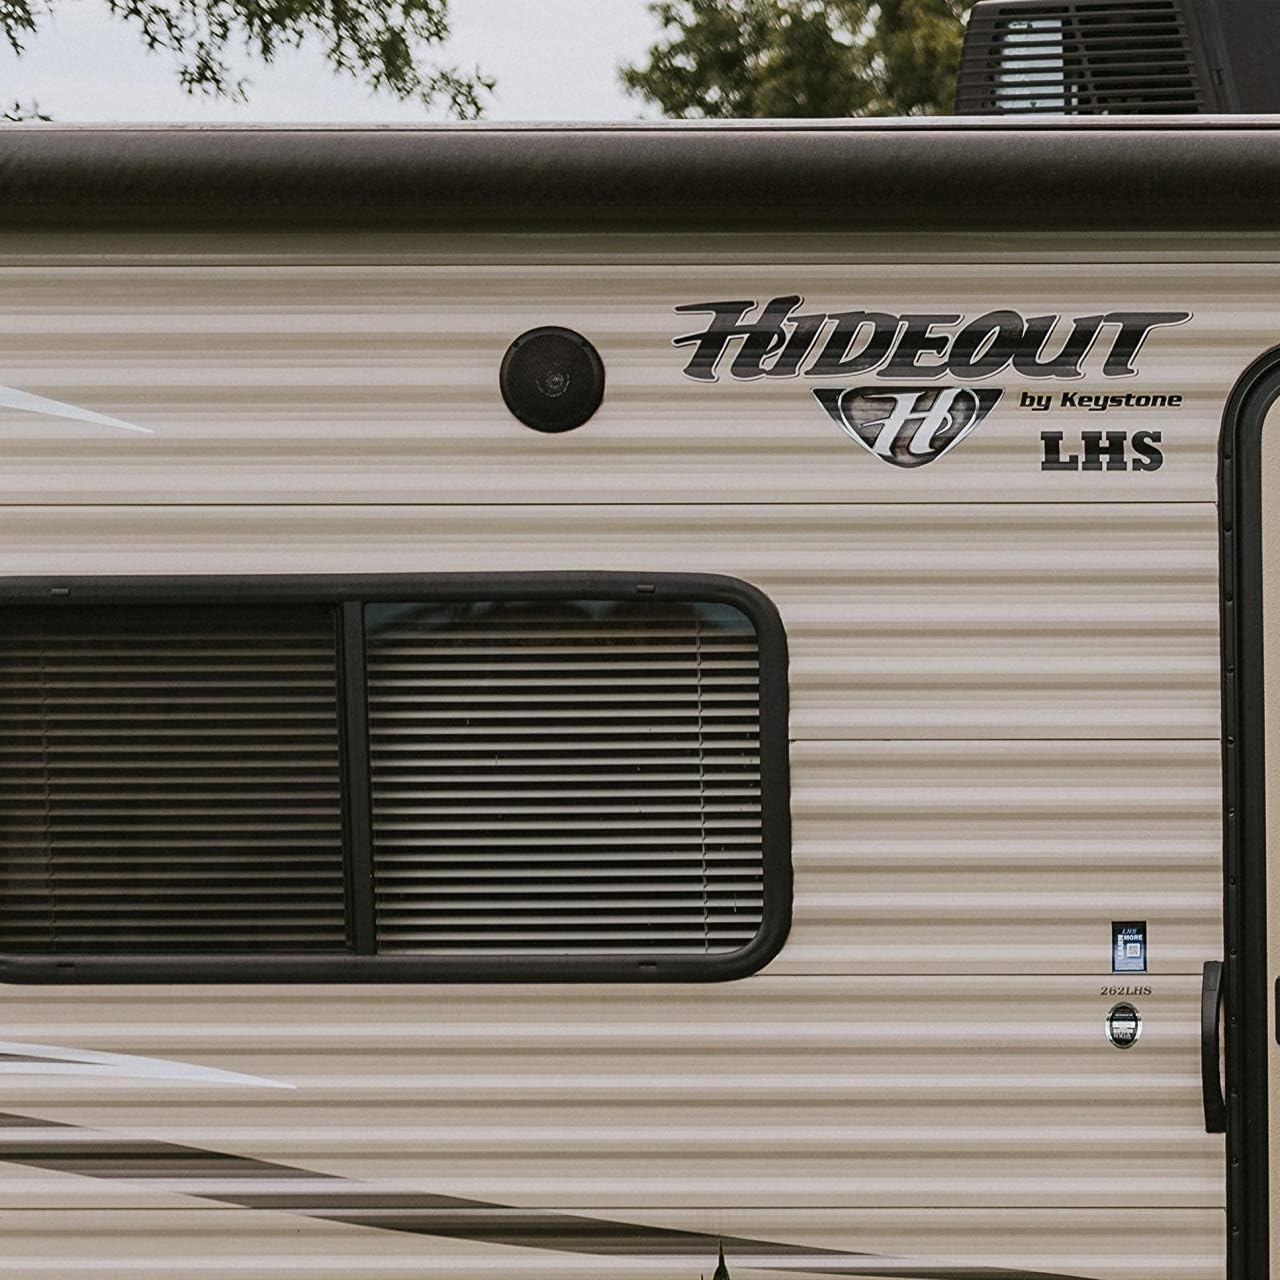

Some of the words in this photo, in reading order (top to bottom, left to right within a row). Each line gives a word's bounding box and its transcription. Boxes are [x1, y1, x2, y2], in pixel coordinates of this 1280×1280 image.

[673, 295, 1193, 382] HIDEOUT
[1019, 392, 1052, 411] by
[1060, 392, 1183, 411] Keystone
[1040, 431, 1164, 472] LHS
[1100, 986, 1152, 996] 262LHS
